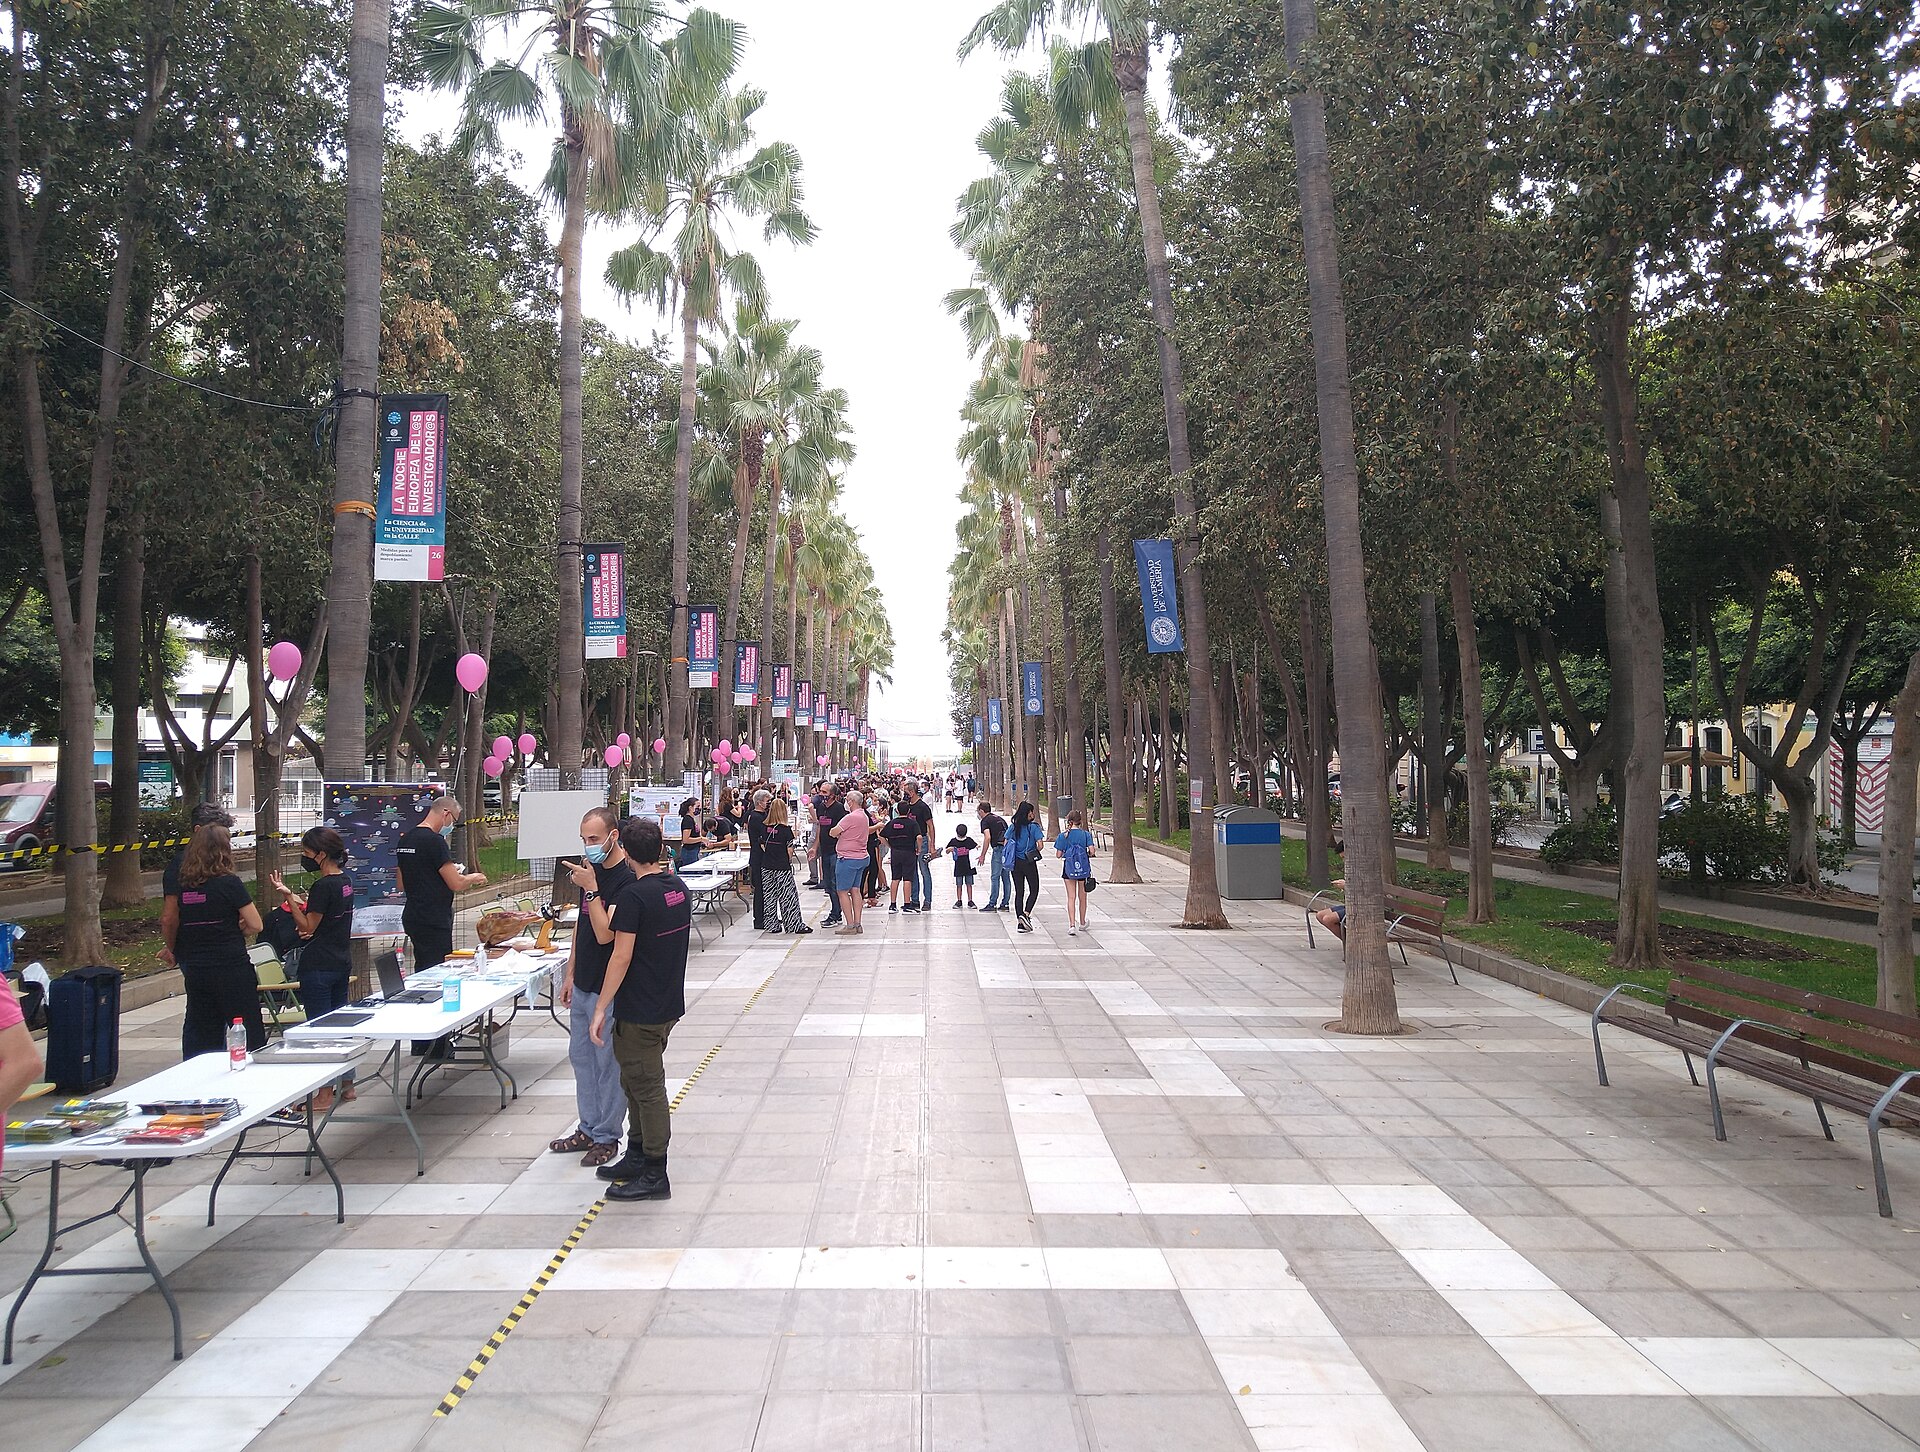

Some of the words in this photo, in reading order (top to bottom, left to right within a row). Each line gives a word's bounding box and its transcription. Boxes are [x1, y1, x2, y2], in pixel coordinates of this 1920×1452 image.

[411, 414, 422, 437] L@S
[410, 439, 421, 454] DE
[394, 451, 406, 490] NOCHE
[422, 414, 436, 513] INVESTIGADOR@S
[409, 459, 420, 513] EUROPEA
[394, 496, 404, 512] LA
[431, 551, 441, 559] 26
[602, 571, 609, 581] DE
[1147, 559, 1160, 613] UNIVERSIDAD
[593, 578, 601, 604] NOCHE
[602, 583, 610, 617] EUROPEA
[594, 607, 601, 617] LA
[1158, 600, 1167, 612] DE
